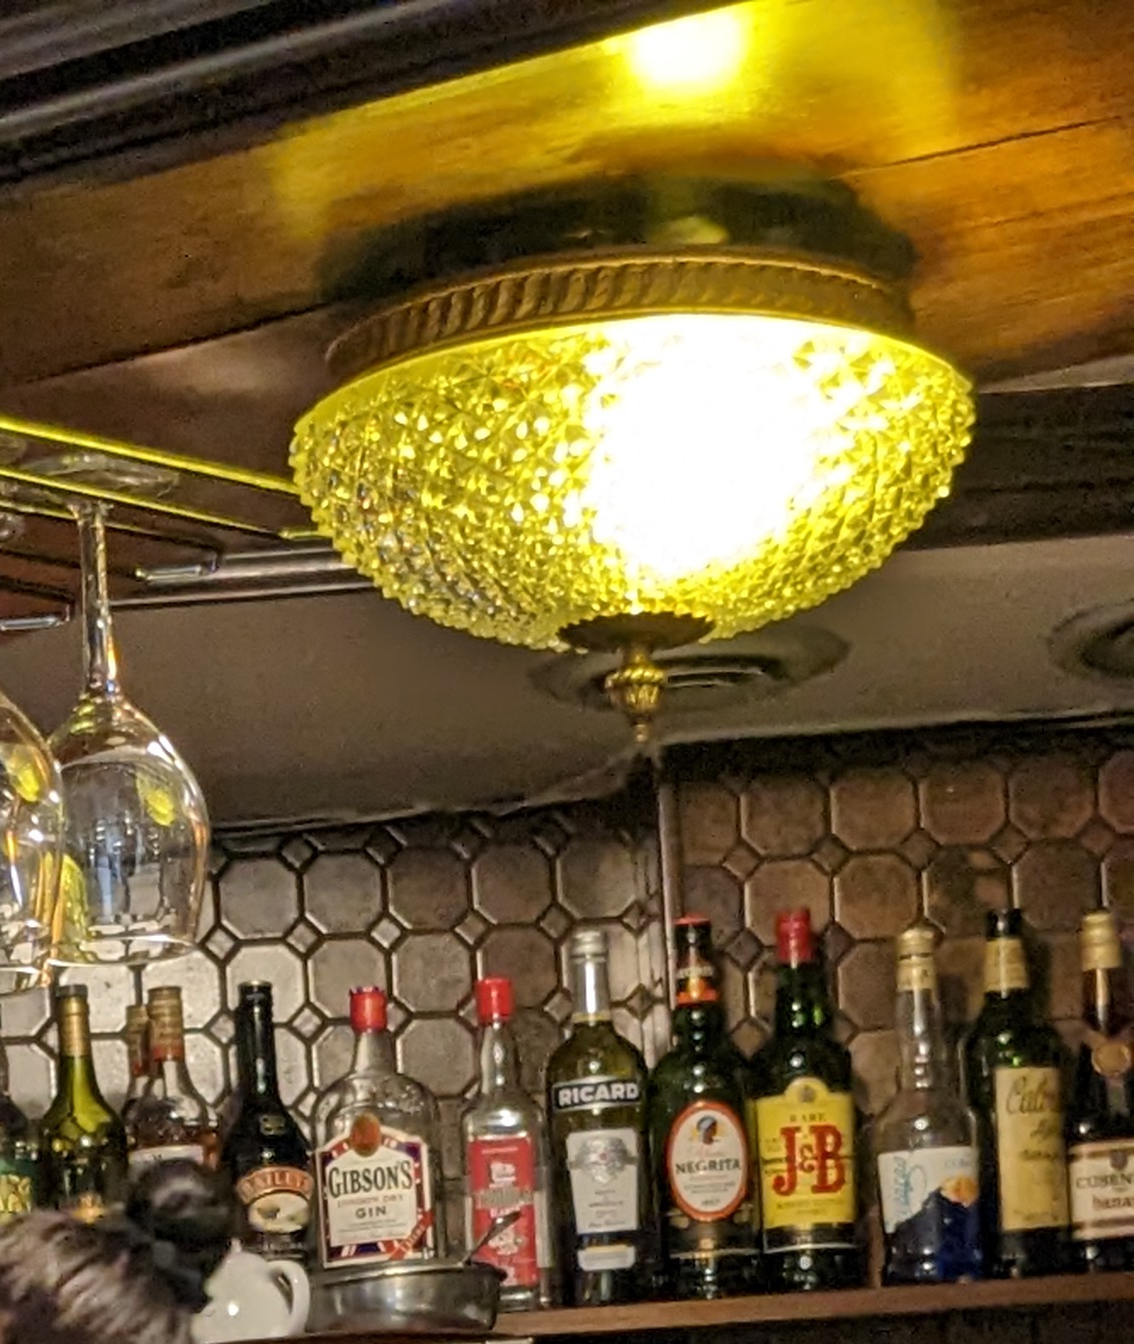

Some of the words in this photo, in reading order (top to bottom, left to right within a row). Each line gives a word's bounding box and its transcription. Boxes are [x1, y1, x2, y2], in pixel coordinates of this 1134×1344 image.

[559, 1082, 640, 1107] RICARD
[675, 1157, 742, 1175] NEGRITA
[772, 1123, 846, 1197] J&B
[328, 1159, 414, 1199] GIBSON'S
[355, 1205, 388, 1219] GIN
